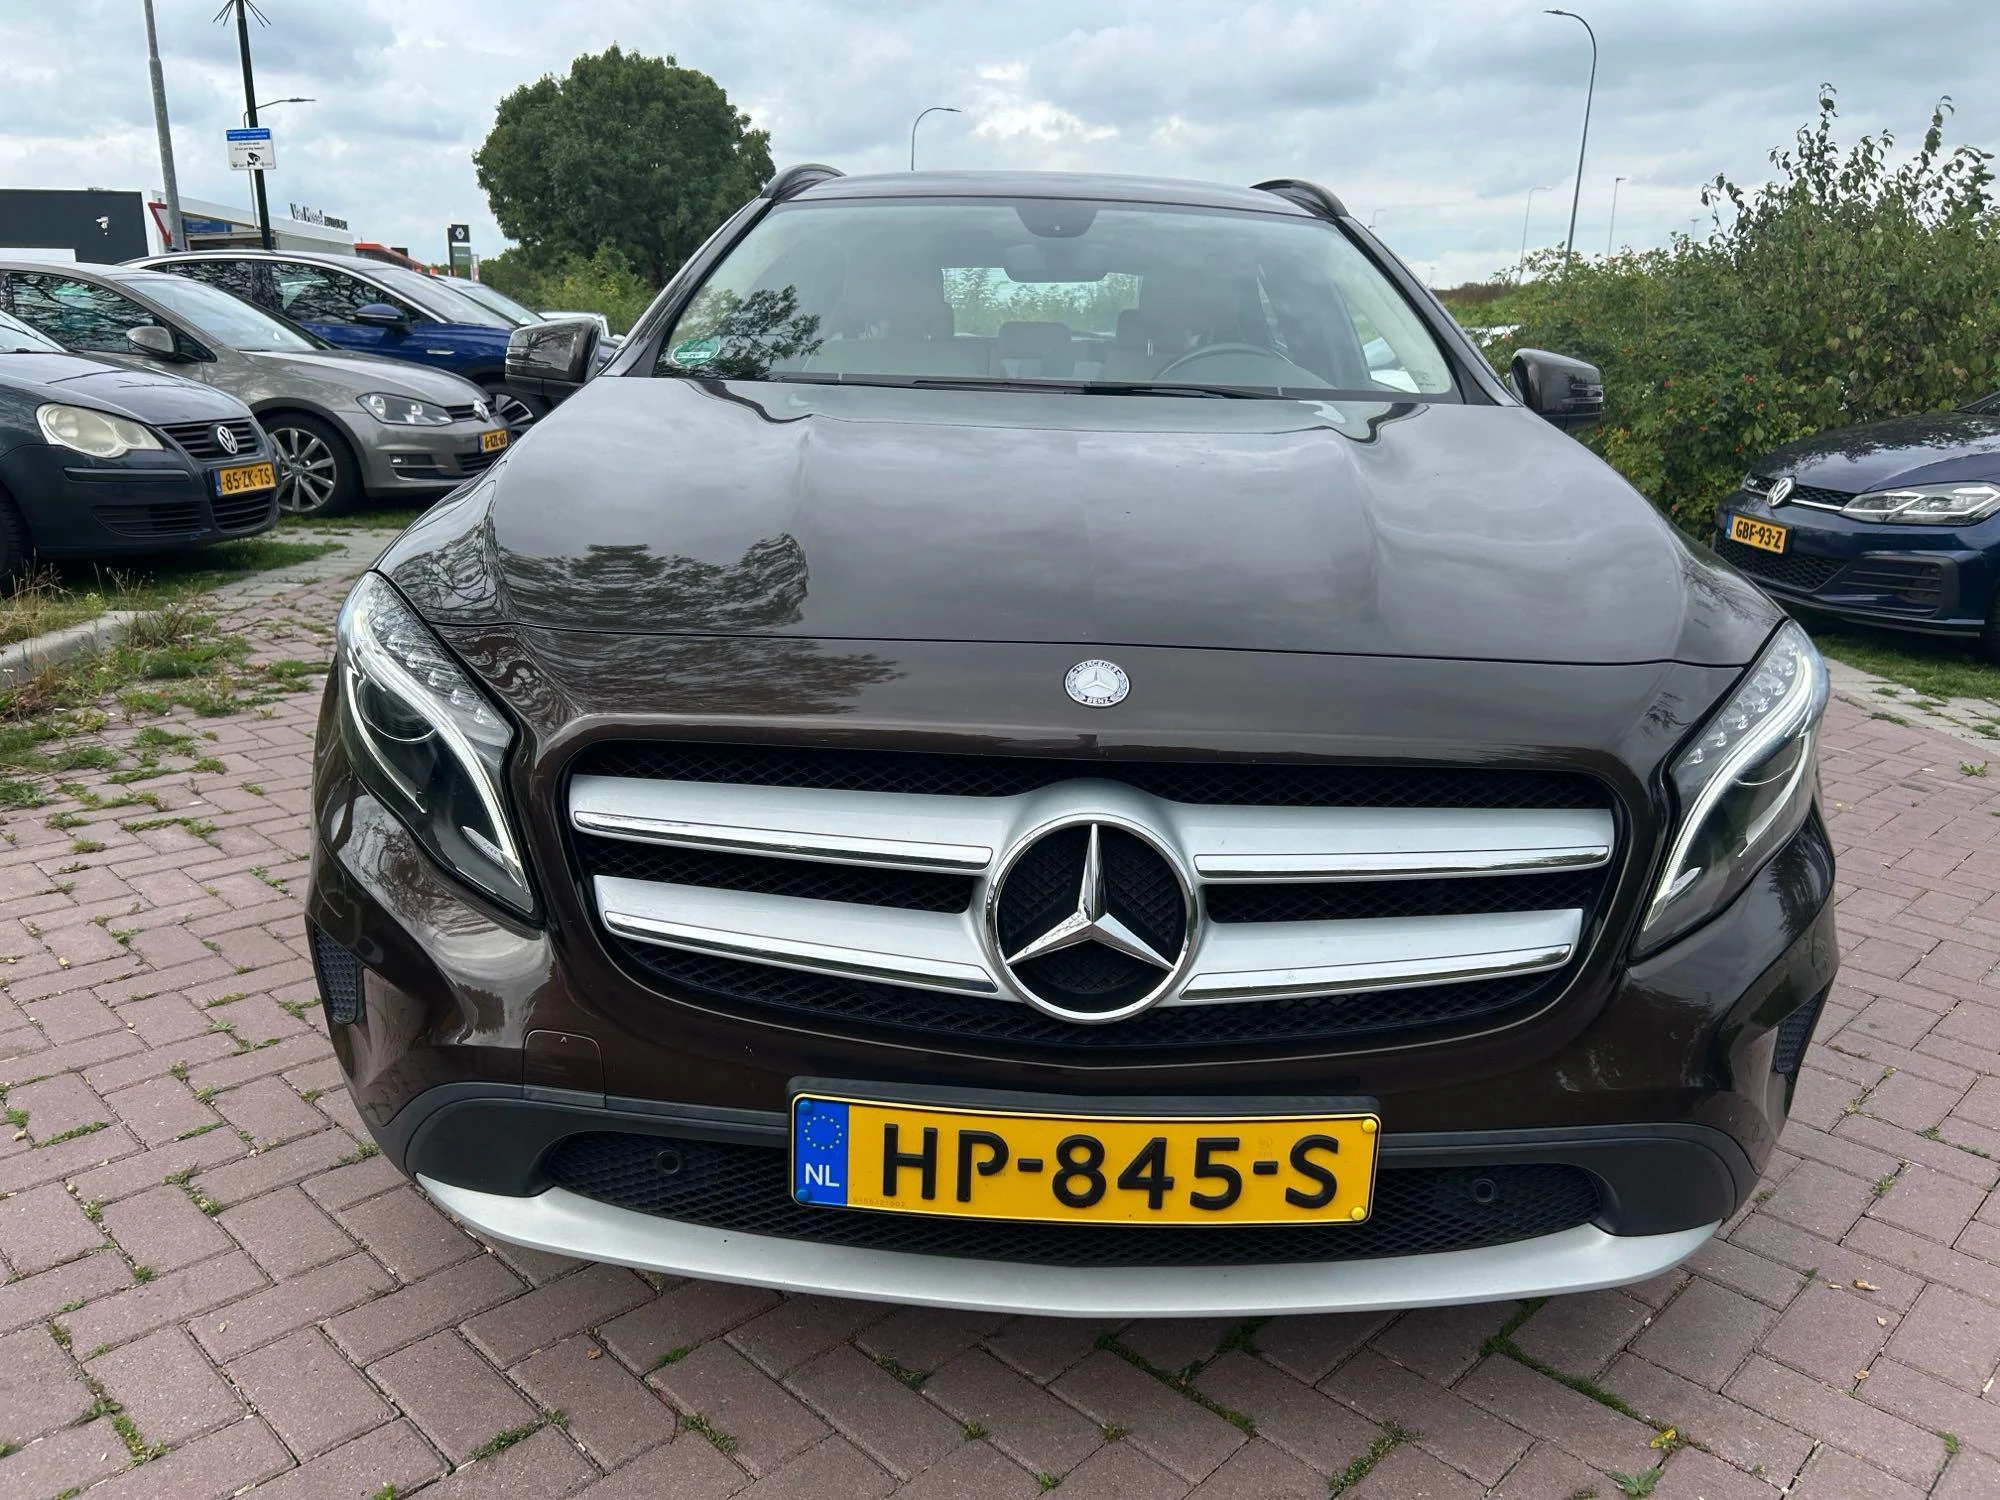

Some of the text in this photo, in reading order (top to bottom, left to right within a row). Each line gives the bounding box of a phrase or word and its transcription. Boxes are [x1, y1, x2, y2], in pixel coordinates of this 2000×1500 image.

[225, 467, 271, 491] 85-ZK-TS
[1735, 519, 1783, 549] GBF-93-Z
[1075, 660, 1119, 674] MERCEDES
[1086, 696, 1110, 705] BENZ
[804, 1162, 840, 1188] NL
[882, 1122, 1339, 1212] HP-845-S
